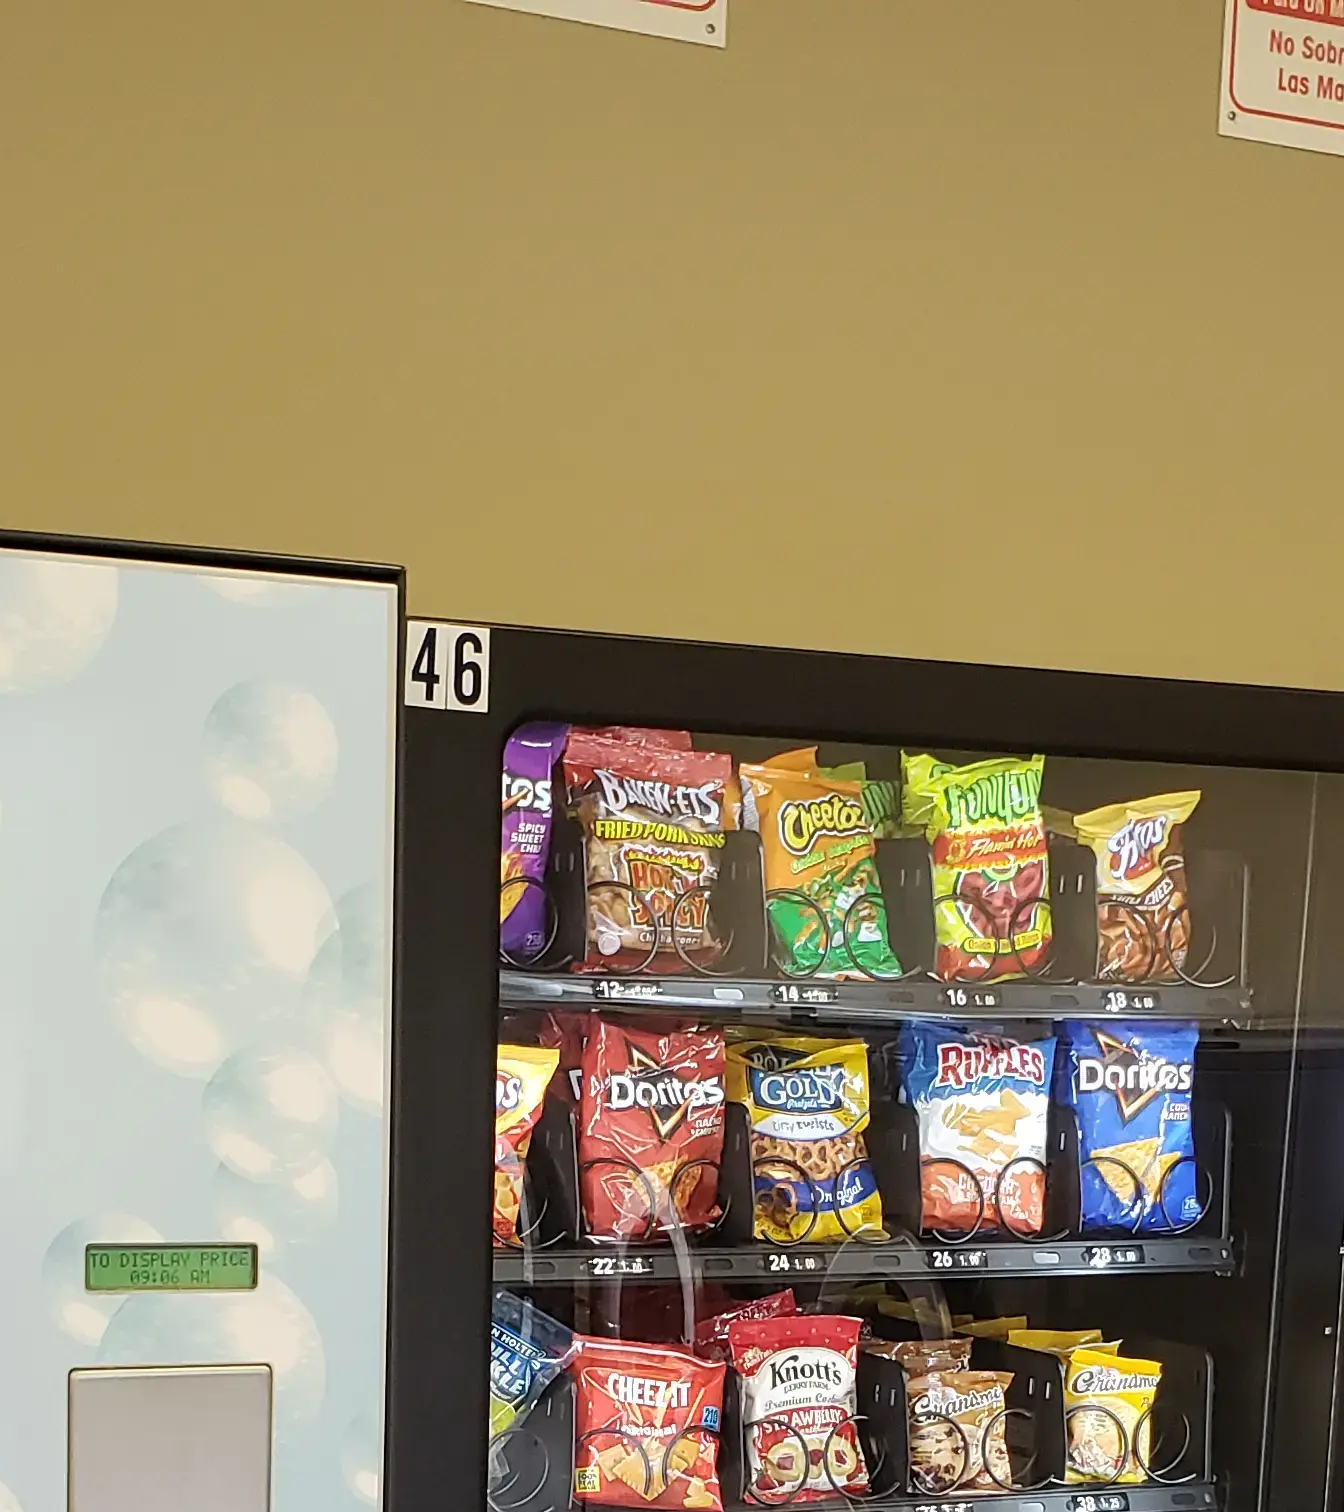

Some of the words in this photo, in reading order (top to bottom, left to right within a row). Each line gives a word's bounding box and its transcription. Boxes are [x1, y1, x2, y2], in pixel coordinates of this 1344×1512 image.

[1269, 29, 1295, 56] No
[1278, 68, 1309, 95] Las
[411, 627, 484, 704] 46
[518, 824, 546, 833] SPICY
[595, 821, 642, 839] FRIED
[510, 834, 545, 843] SWEET
[947, 990, 965, 1006] 16
[1080, 1060, 1191, 1090] Doritos
[610, 1076, 724, 1108] Doritos
[761, 1077, 834, 1105] GOLD
[796, 1120, 834, 1131] twists
[90, 1253, 110, 1268] TO
[120, 1253, 190, 1268] DISPLAY
[200, 1252, 249, 1266] PRICE
[769, 1255, 789, 1270] 24
[933, 1252, 952, 1267] 26
[130, 1270, 180, 1284] 09:06
[191, 1270, 210, 1283] AM
[770, 1355, 842, 1390] Knott's
[764, 1396, 811, 1411] Premium
